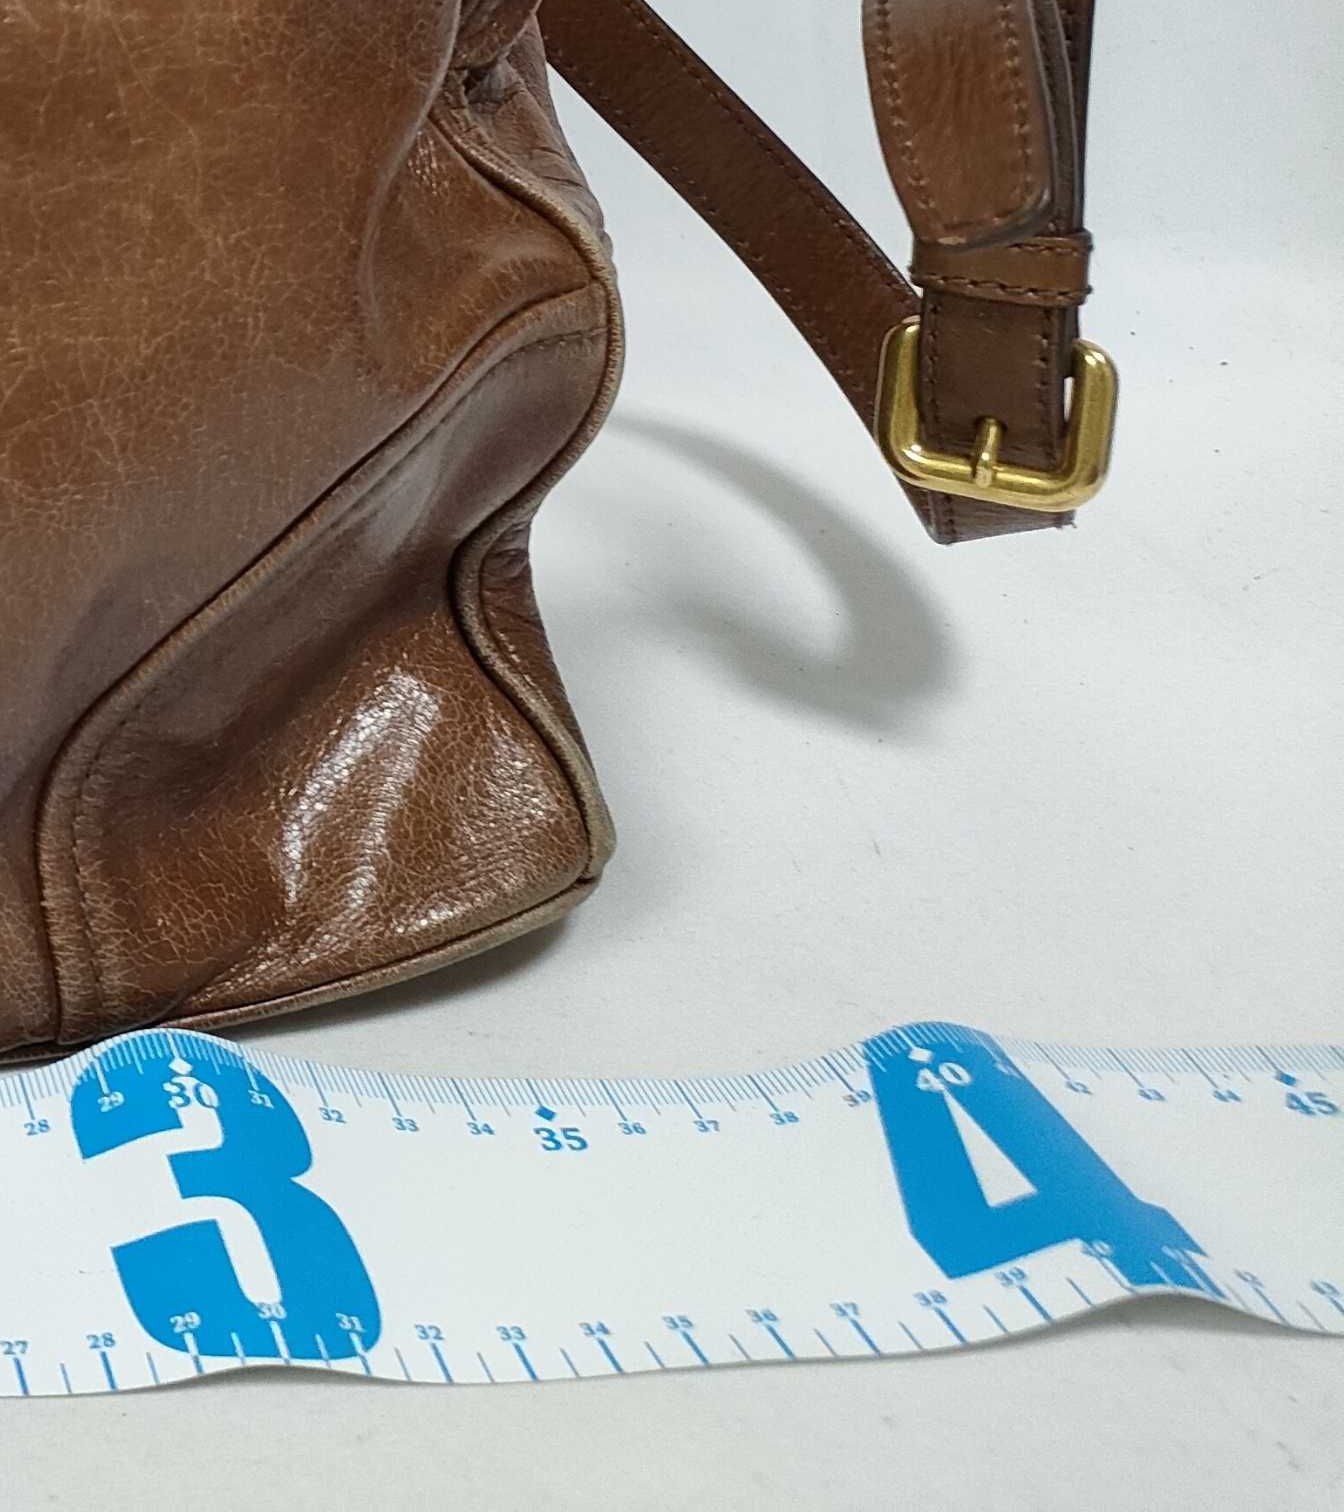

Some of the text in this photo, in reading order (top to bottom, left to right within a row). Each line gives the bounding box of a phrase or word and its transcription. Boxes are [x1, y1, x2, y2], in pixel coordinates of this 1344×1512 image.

[23, 1119, 51, 1136] 28
[162, 1076, 220, 1110] 30
[318, 1106, 346, 1125] 32
[391, 1116, 420, 1133] 33
[467, 1121, 496, 1137] 34
[533, 1126, 589, 1152] 35
[617, 1121, 647, 1137] 36
[693, 1118, 721, 1134] 37
[769, 1110, 801, 1127] 38
[916, 1061, 973, 1093] 40
[70, 1031, 382, 1360] 3
[862, 1021, 1226, 1299] 4
[0, 1340, 28, 1355] 27
[86, 1332, 115, 1349] 28
[169, 1311, 201, 1333] 29
[336, 1312, 367, 1333] 31
[414, 1324, 444, 1341] 32
[496, 1325, 528, 1341] 33
[579, 1322, 611, 1337] 34
[662, 1315, 694, 1331] 35
[746, 1309, 778, 1324] 36
[829, 1302, 860, 1318] 37
[912, 1290, 948, 1307] 38
